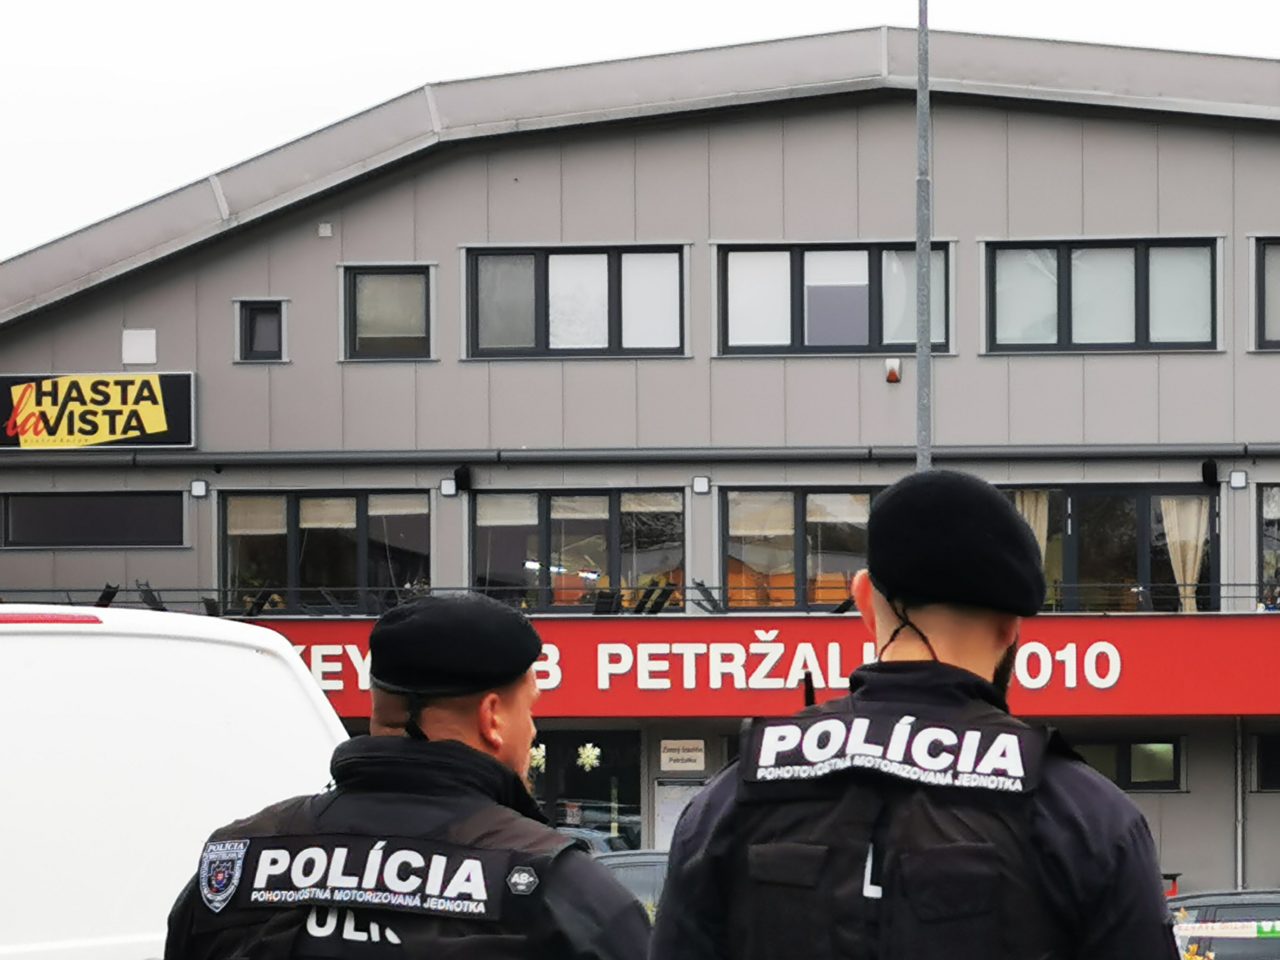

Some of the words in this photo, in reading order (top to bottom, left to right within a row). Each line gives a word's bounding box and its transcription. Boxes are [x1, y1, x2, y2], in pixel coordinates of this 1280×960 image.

[35, 380, 159, 407] HASTA
[39, 408, 147, 437] VISTA
[293, 645, 371, 690] EY
[1014, 641, 1121, 690] 010
[757, 715, 1025, 778] POLÍCIA
[253, 840, 488, 900] POLÍCIA
[333, 888, 421, 908] MOTORIZOVANÁ
[423, 898, 486, 913] JEDNOTKA
